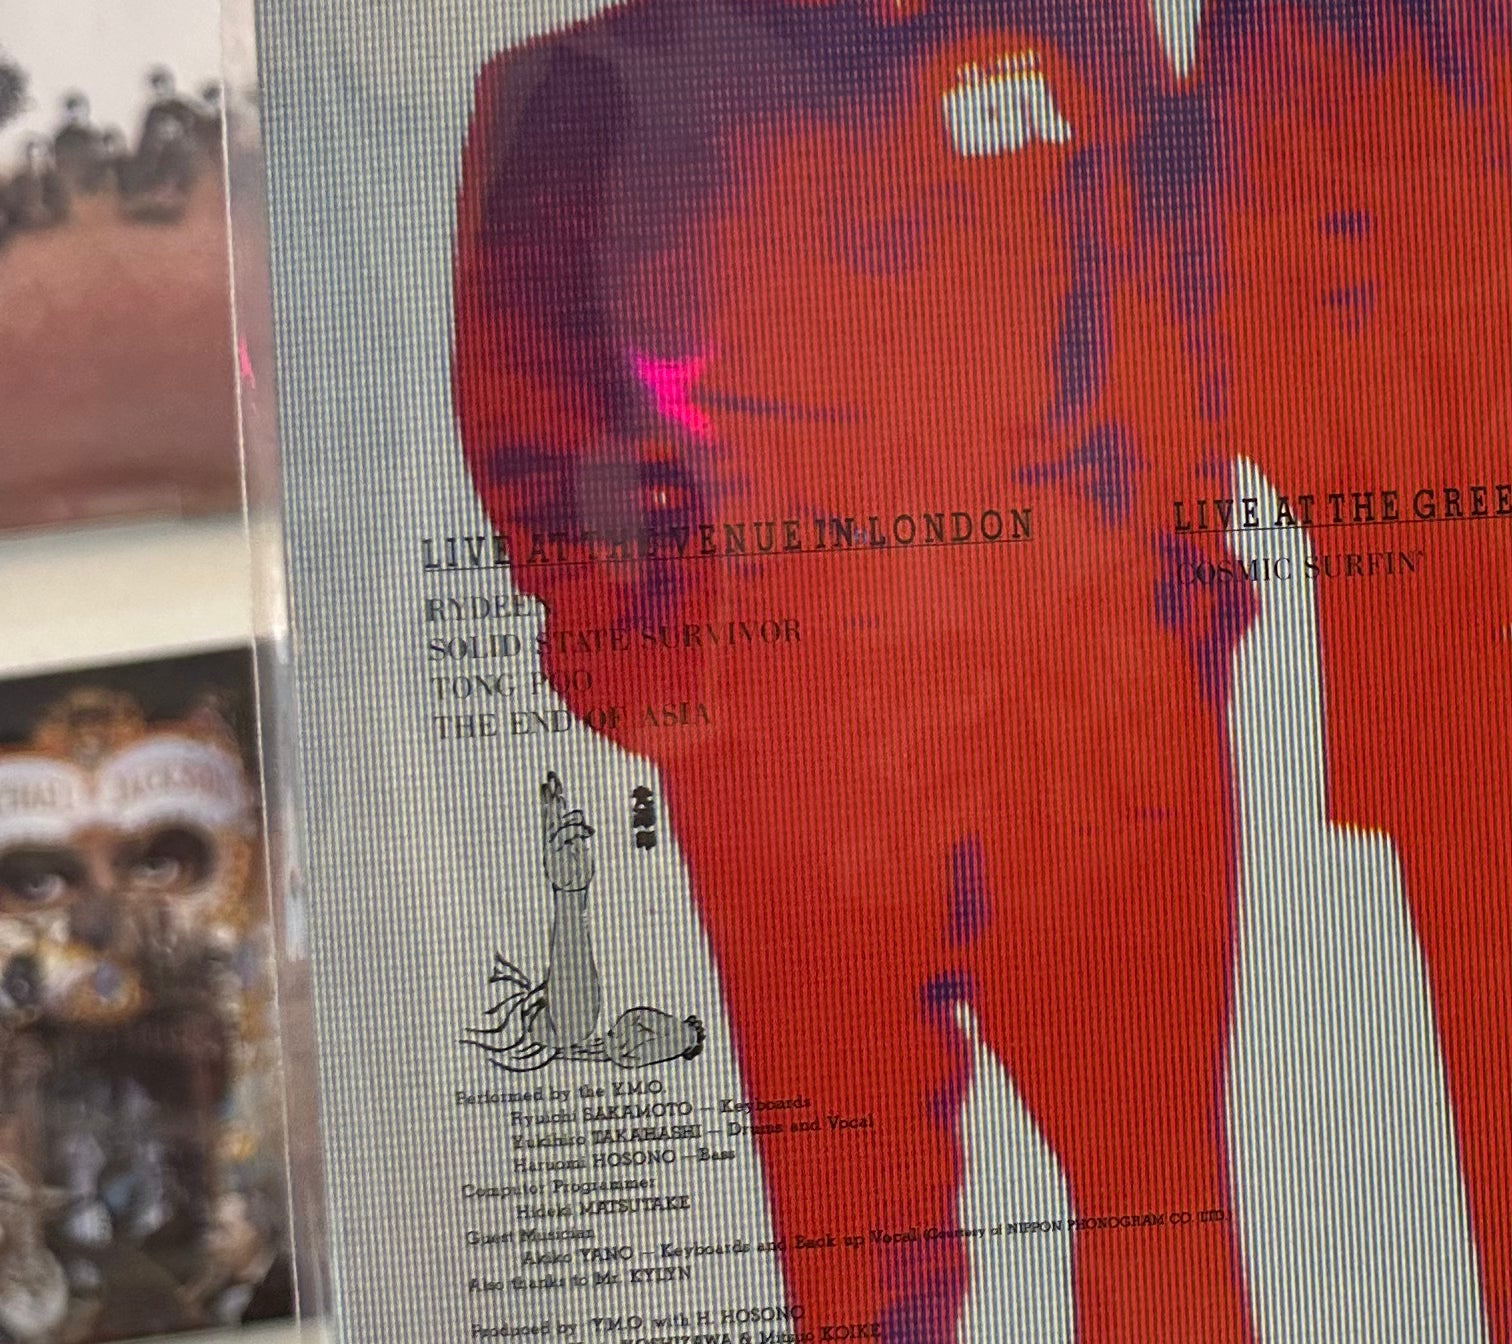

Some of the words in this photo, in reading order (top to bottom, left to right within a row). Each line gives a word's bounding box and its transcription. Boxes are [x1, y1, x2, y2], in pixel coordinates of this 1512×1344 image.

[1173, 498, 1259, 531] LIVE
[1275, 494, 1315, 526] AT
[1329, 490, 1400, 523] THE
[422, 535, 511, 568] LIVE
[669, 520, 801, 556] VENUE
[818, 518, 860, 548] IN
[868, 509, 1033, 547] LONDON
[1178, 557, 1293, 585] COSMIC
[429, 632, 521, 661] SOLID
[641, 618, 802, 650] SURVIVOR
[431, 673, 515, 700] TONG
[531, 669, 593, 695] POO
[433, 713, 497, 740] THE
[512, 709, 572, 735] END
[643, 702, 712, 727] ASIA
[583, 1101, 693, 1123] SAKAMOTO
[591, 1124, 701, 1146] TAKAHASHI
